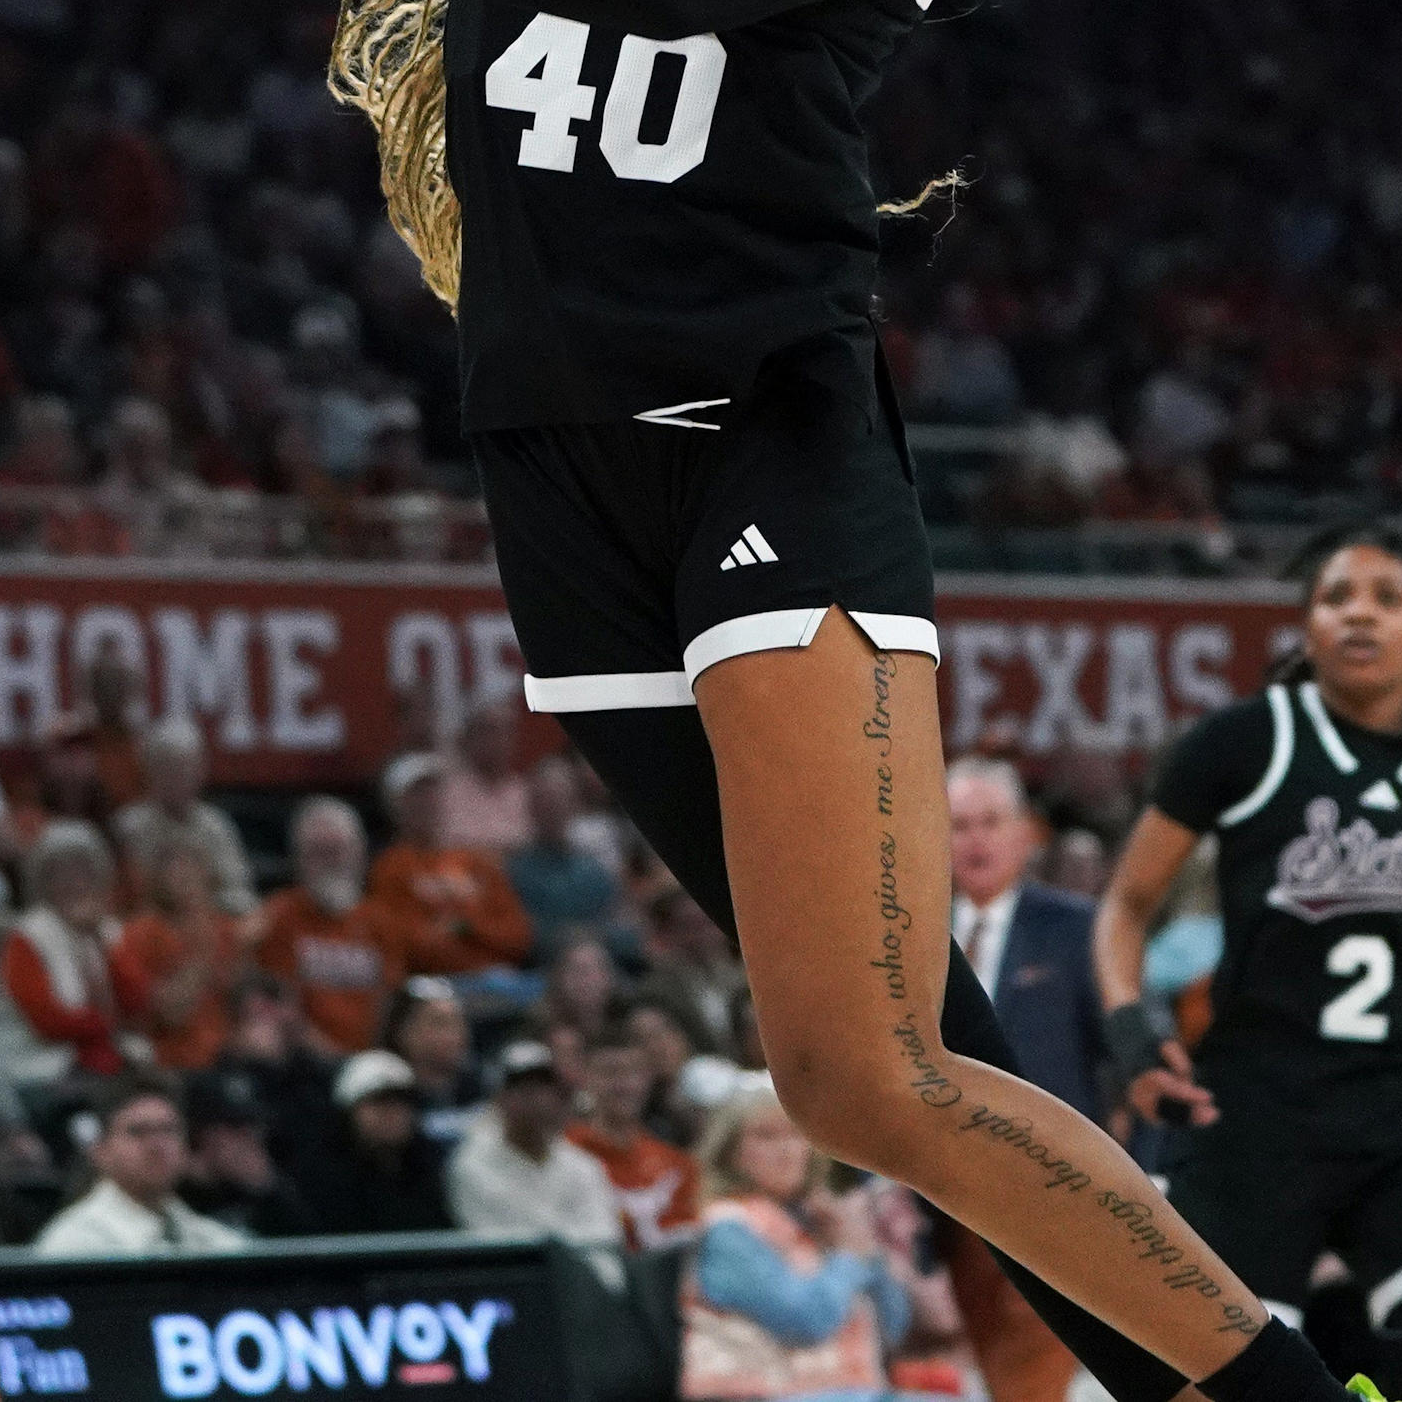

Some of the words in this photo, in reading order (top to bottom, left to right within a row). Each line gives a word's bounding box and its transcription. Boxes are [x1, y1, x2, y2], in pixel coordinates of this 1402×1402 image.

[486, 11, 728, 184] 40
[948, 620, 1236, 754] EXAS
[878, 764, 894, 817] me
[874, 831, 913, 931] gives
[870, 929, 906, 1000] who
[1317, 932, 1396, 1043] 2
[959, 1105, 1092, 1192] through
[1097, 1190, 1184, 1265] things
[1163, 1264, 1222, 1298] all
[1214, 1301, 1261, 1335] do
[151, 1300, 500, 1398] BONVOY
